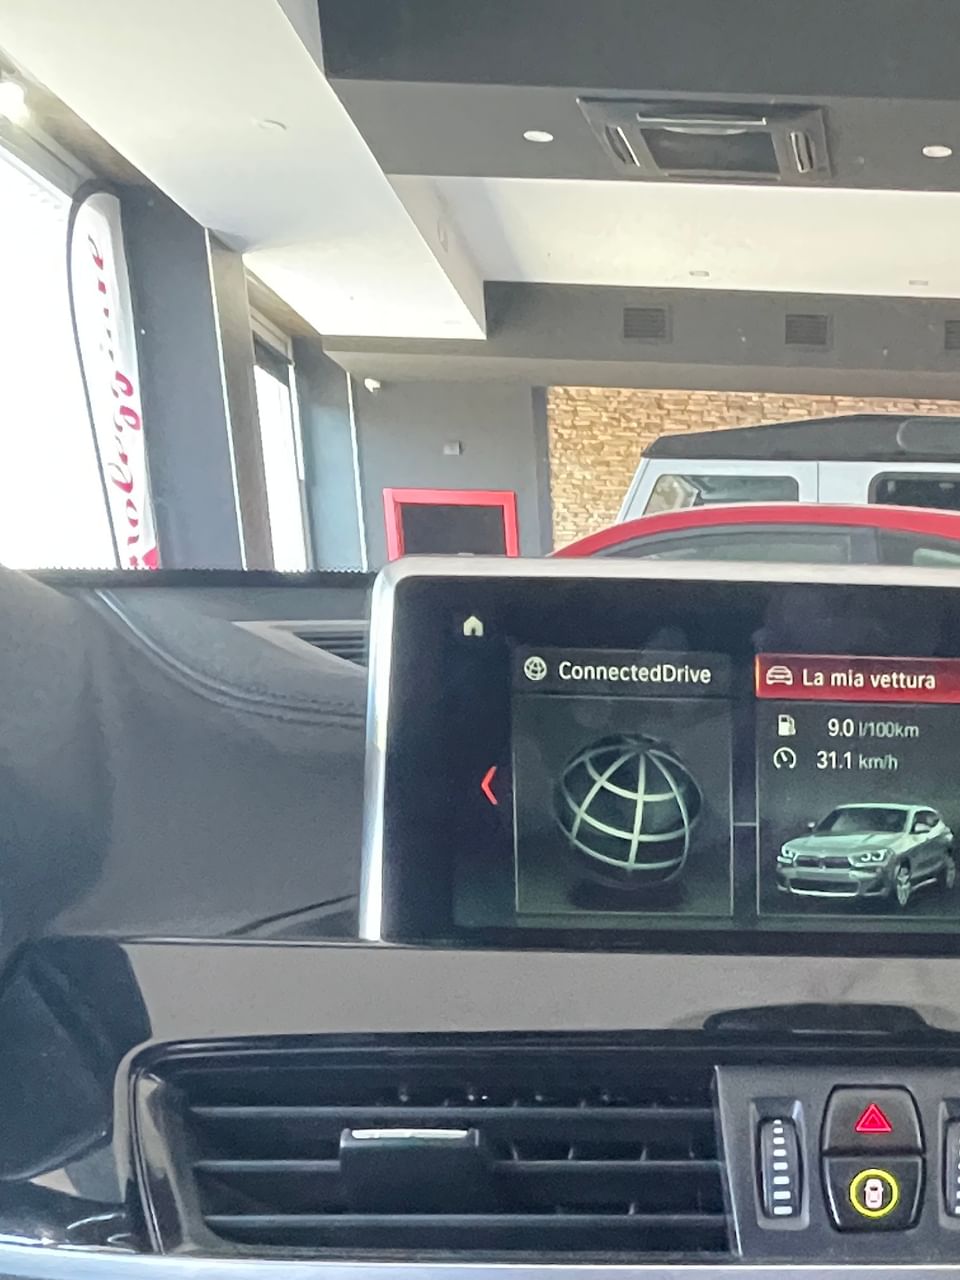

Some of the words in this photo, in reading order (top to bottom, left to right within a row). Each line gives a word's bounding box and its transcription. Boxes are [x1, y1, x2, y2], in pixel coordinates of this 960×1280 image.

[558, 661, 712, 684] ConnectedDrive
[802, 668, 824, 686] La
[830, 669, 864, 688] mia
[870, 671, 936, 690] vettura
[827, 718, 855, 737] 9.0
[816, 750, 852, 769] 31.1
[858, 753, 898, 770] km/h
